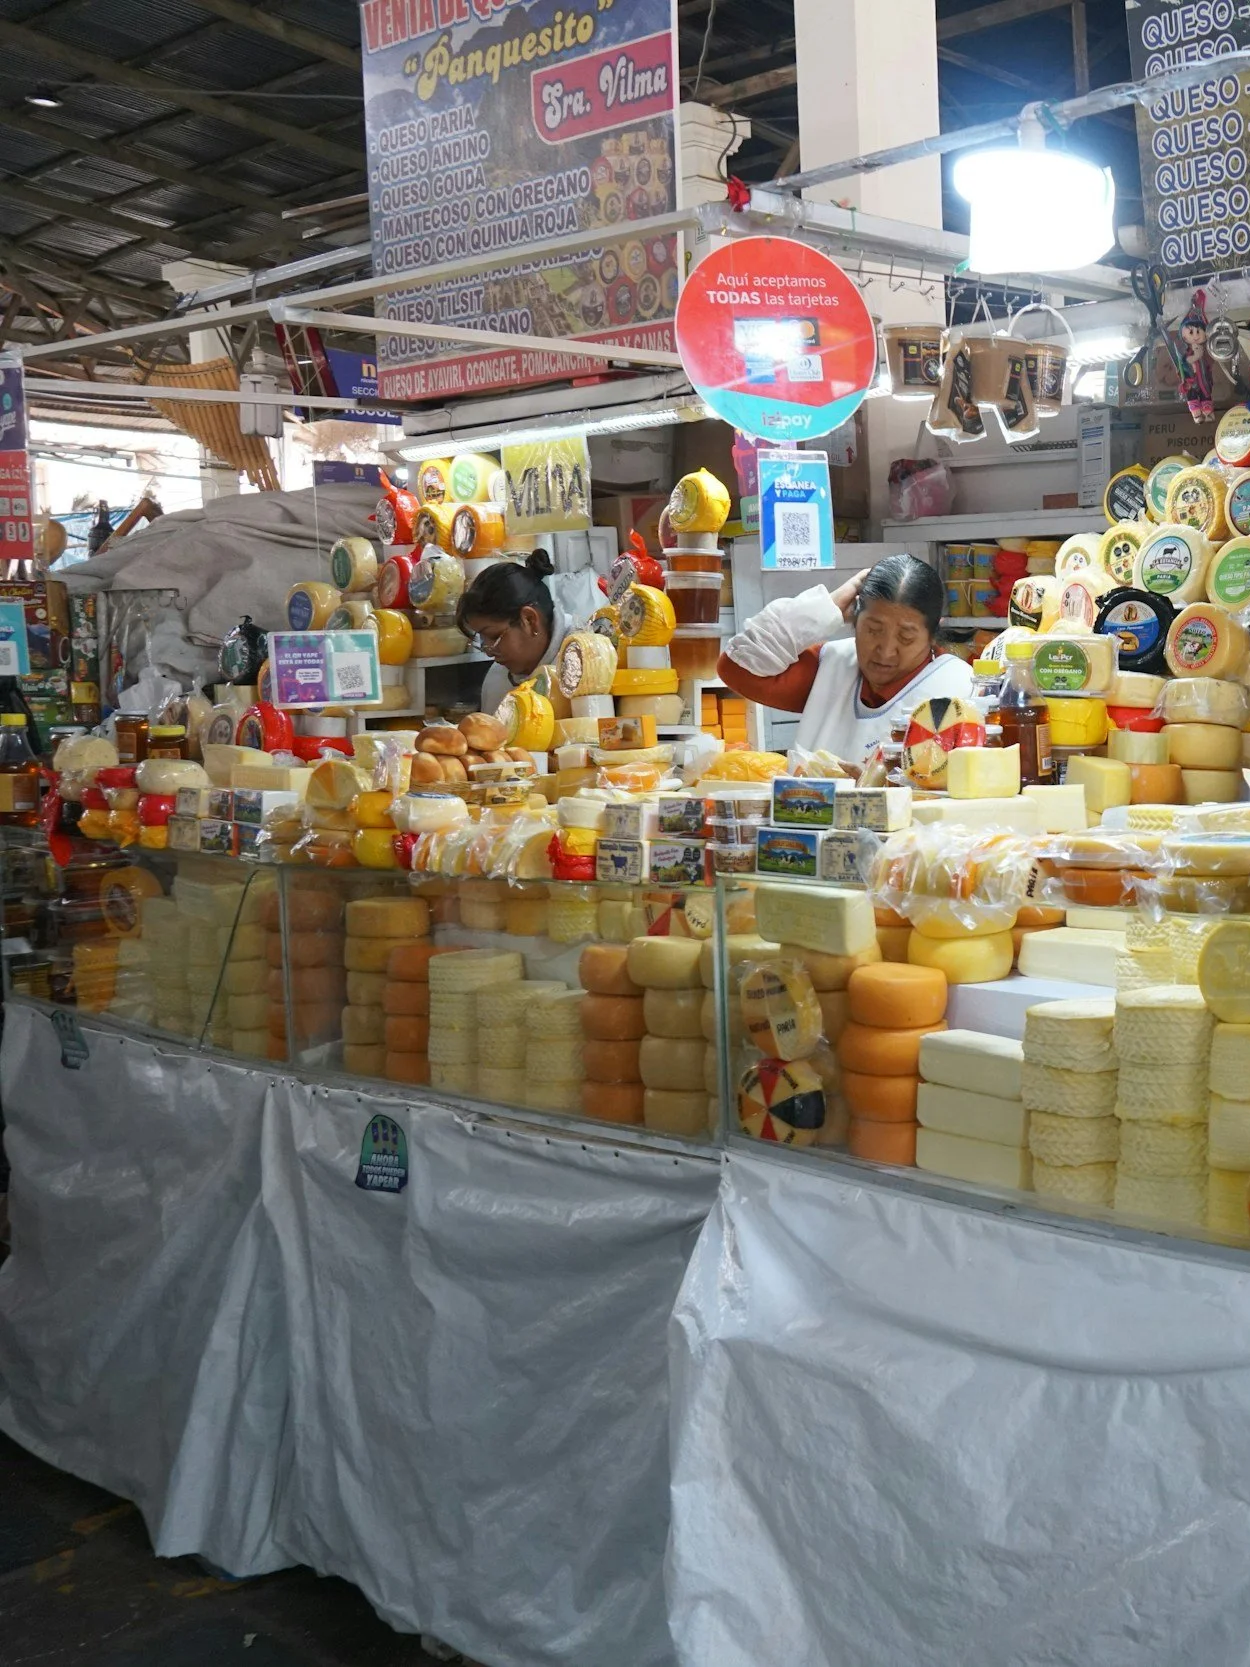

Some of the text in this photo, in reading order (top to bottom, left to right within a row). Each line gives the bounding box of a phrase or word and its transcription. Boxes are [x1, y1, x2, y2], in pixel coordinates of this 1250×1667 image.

[1142, 0, 1234, 50] QUESO
[542, 53, 669, 130] Sra. Vilma
[1150, 74, 1240, 123] QUESO
[379, 104, 477, 153] QUESO PARIA
[1152, 110, 1243, 159] QUESO
[380, 131, 491, 186] QUESO ANDINO
[1155, 147, 1247, 195] QUESO
[381, 163, 488, 214] QUESO GOUDA
[382, 165, 592, 244] MANTECOSO CON OREGANO
[1158, 184, 1249, 231] QUESO
[384, 203, 580, 273] QUESO CON QUINUA ROJA
[436, 286, 485, 318] TILSIT
[706, 290, 839, 308] TODAS las tarjetas
[717, 273, 827, 289] Aquí aceptamos
[384, 374, 413, 400] QUESO
[414, 374, 426, 394] DE
[428, 363, 465, 392] AYAVIRI,
[467, 355, 521, 385] OCONGATE,
[1149, 424, 1176, 436] PERU
[1167, 436, 1198, 448] PISCO
[774, 480, 817, 490] ESCANEA
[782, 490, 807, 498] PAGA
[366, 1174, 400, 1189] YAPEAR
[370, 1153, 399, 1168] AHORA
